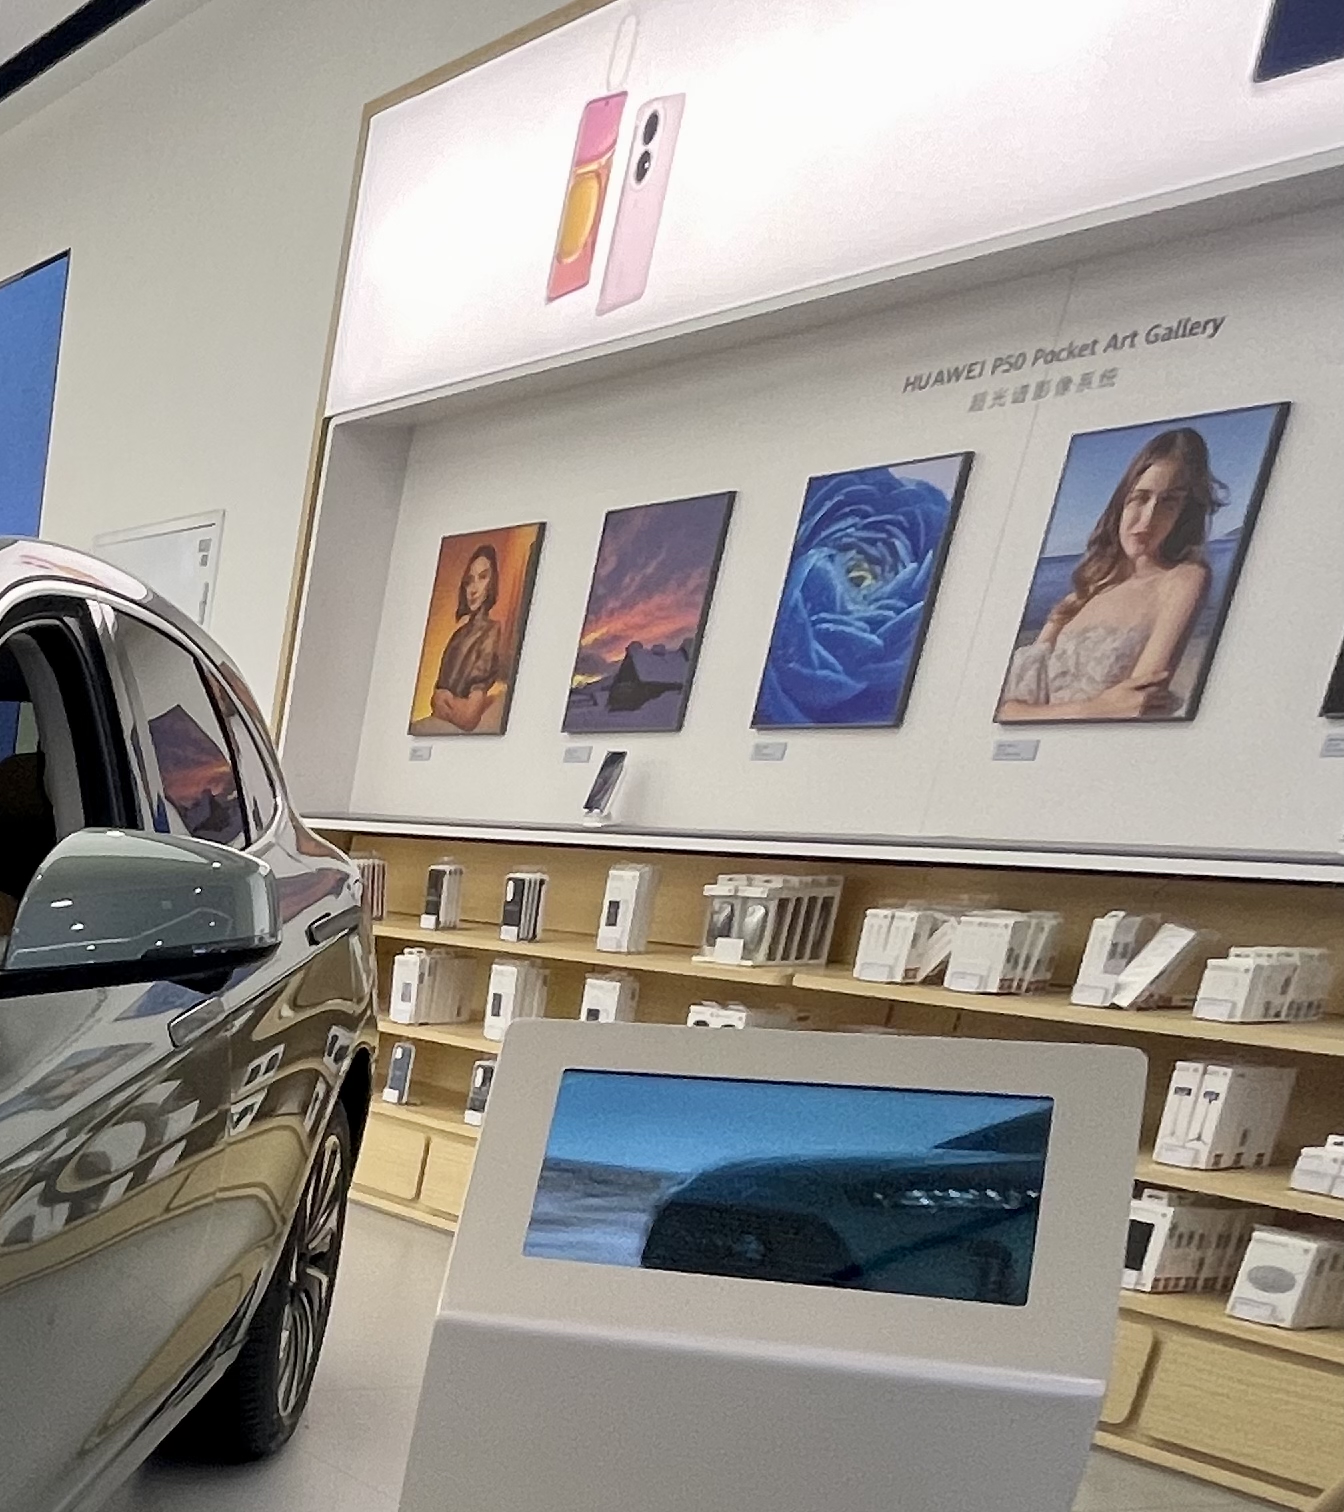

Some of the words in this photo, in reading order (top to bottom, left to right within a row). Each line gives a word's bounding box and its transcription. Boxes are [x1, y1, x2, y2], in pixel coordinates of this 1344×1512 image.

[902, 361, 987, 394] HUAWEI
[990, 351, 1028, 376] P50
[1031, 338, 1099, 368] Pocket
[1102, 329, 1139, 354] Art
[1144, 315, 1227, 346] Gallery
